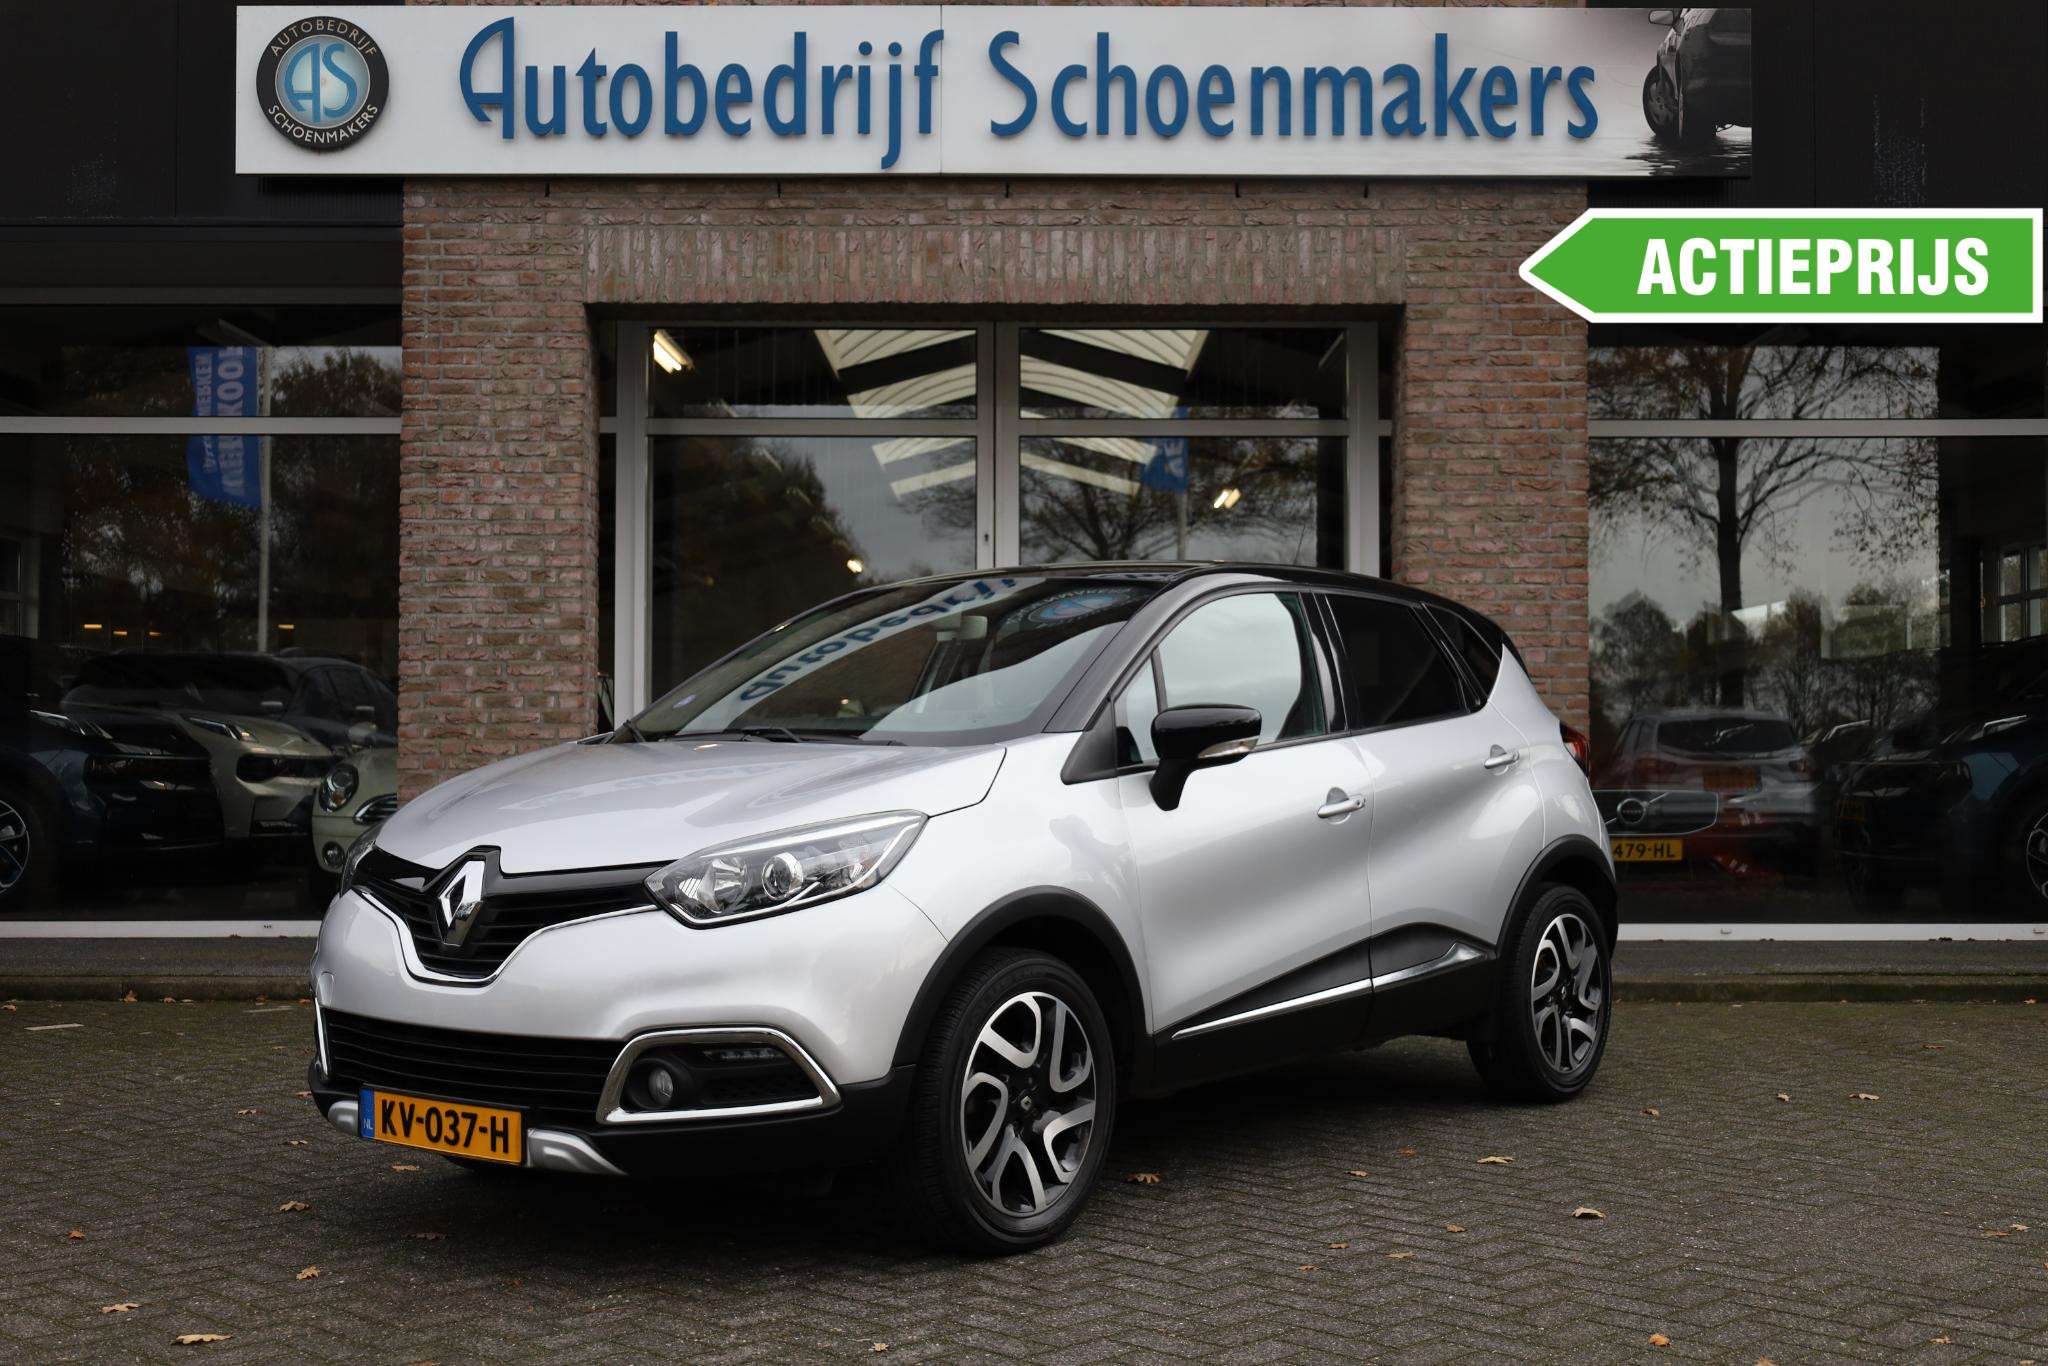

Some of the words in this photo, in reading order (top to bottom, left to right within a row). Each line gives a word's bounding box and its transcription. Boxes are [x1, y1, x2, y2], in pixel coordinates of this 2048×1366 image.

[270, 18, 378, 58] AUTOBEDRIJF
[284, 42, 358, 123] AS
[459, 16, 945, 171] Autobedrijf
[988, 29, 1600, 140] Schoenmakers
[268, 103, 379, 144] SCHOENMAKERS
[363, 1118, 374, 1130] NL
[381, 1098, 509, 1154] KV-037-H
